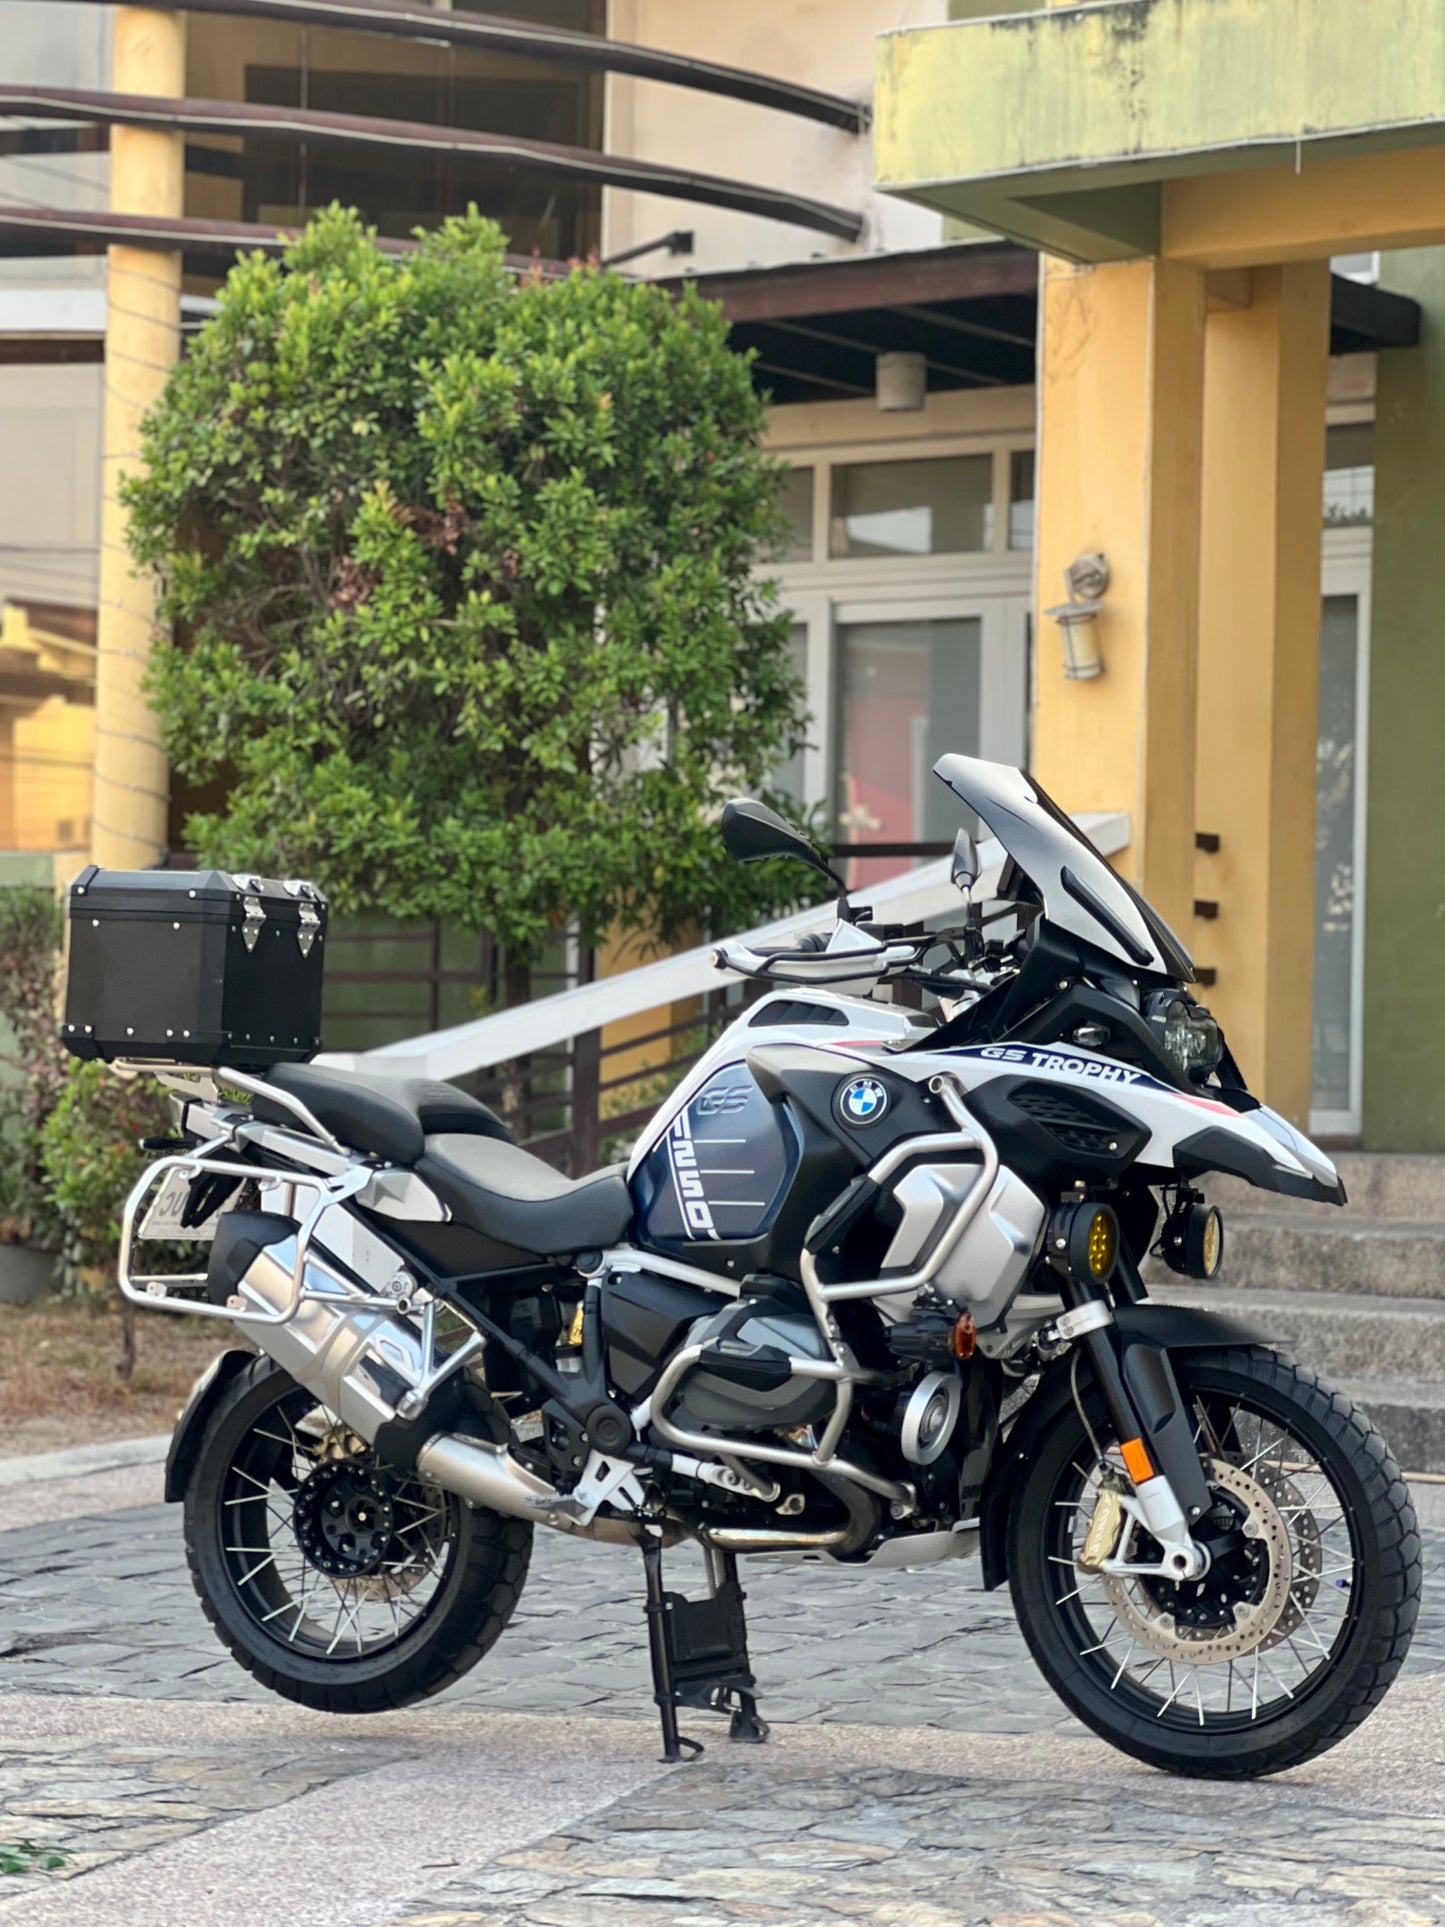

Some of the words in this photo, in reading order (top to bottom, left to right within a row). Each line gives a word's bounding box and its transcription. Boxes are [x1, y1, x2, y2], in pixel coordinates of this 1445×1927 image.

[980, 1047, 1027, 1061] GS
[1032, 1052, 1141, 1084] TROPHY
[696, 1085, 754, 1115] GS
[849, 1080, 883, 1098] BMW
